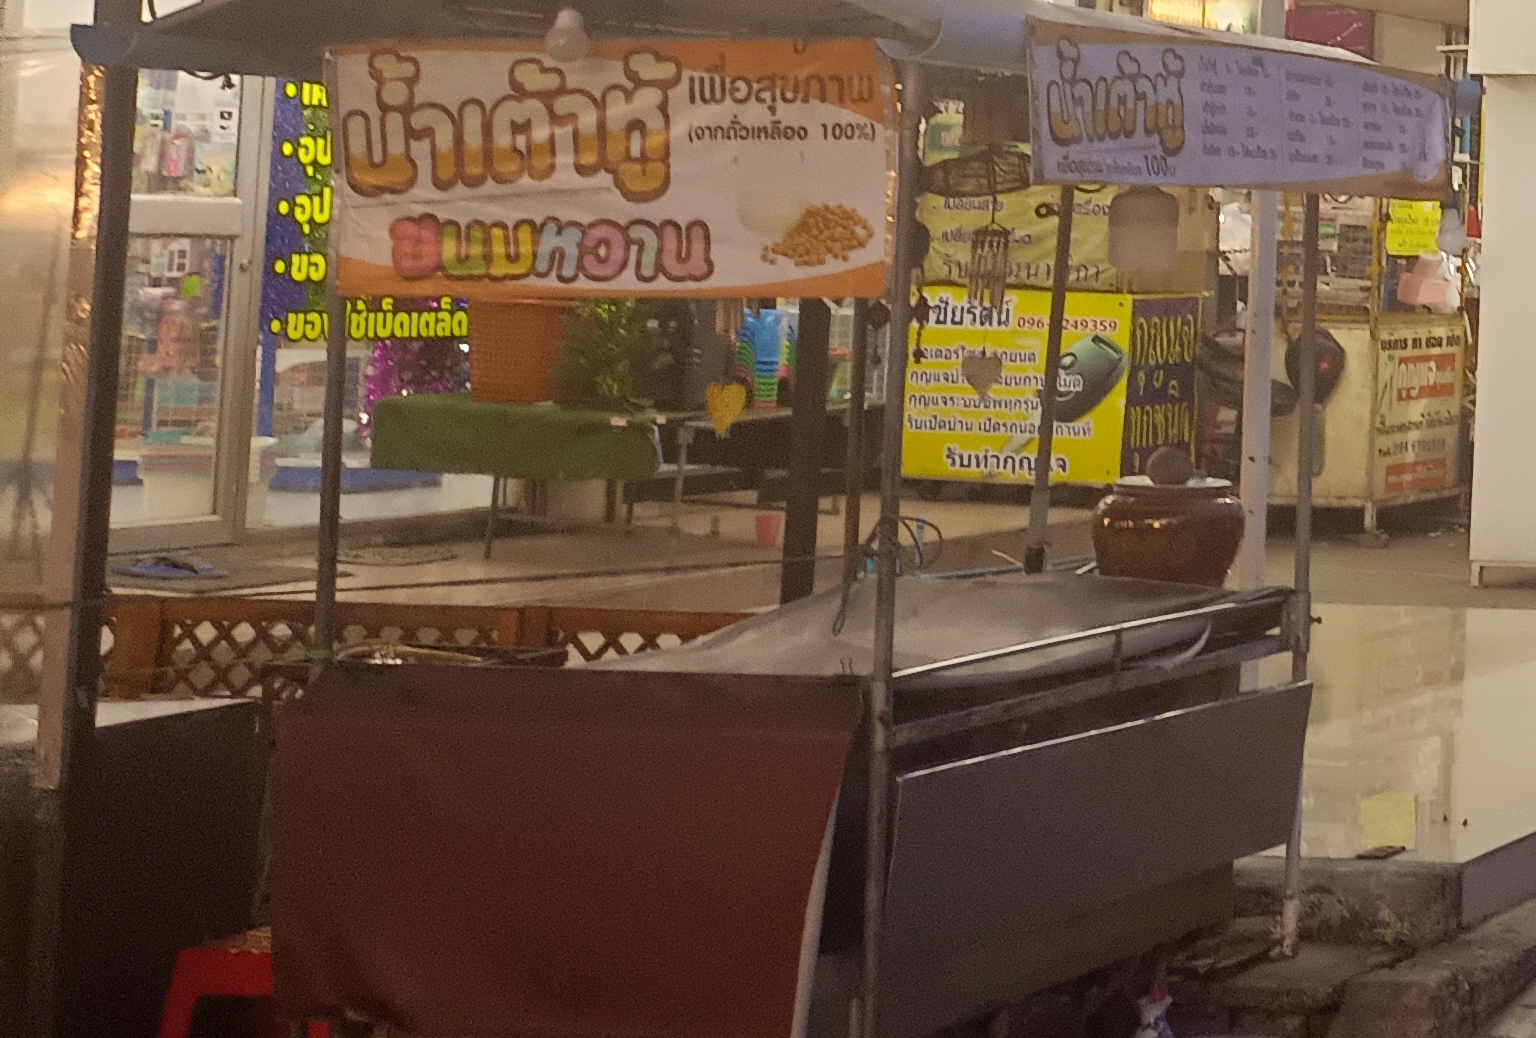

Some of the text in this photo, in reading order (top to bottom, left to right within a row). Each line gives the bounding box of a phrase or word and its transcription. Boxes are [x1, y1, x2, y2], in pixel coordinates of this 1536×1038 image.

[687, 63, 875, 117] เพื่อสุขภาพ
[341, 47, 683, 202] น้ำเต้าหู้
[819, 120, 877, 144] 100%)
[389, 213, 715, 283] ขนมหวาน
[945, 445, 1068, 475] รับทำกุญจ
